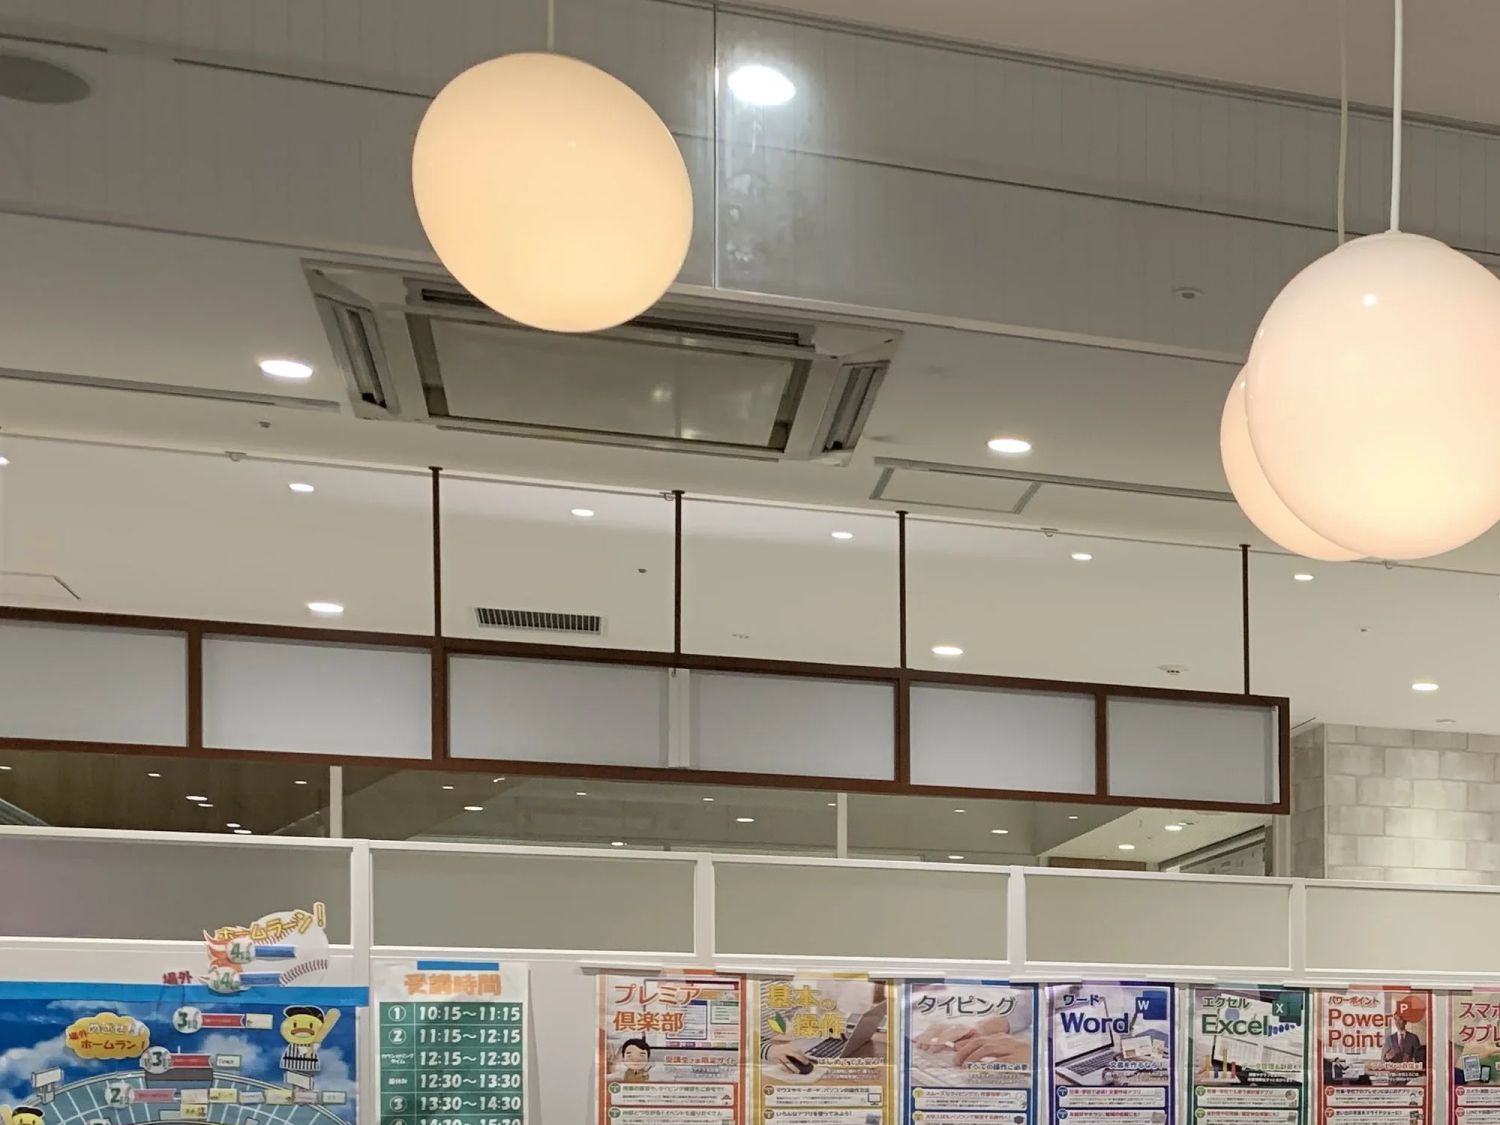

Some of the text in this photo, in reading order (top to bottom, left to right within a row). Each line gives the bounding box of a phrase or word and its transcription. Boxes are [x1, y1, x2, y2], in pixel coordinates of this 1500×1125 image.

[404, 973, 502, 996] 受講時間
[614, 984, 699, 1005] プレミア
[768, 985, 837, 1011] 基本の
[1063, 994, 1101, 1006] ワード
[1203, 997, 1250, 1009] エクセル
[1328, 996, 1380, 1005] パワーポイント
[917, 995, 1016, 1015] タイピング
[1137, 1000, 1150, 1011] W
[1275, 1003, 1284, 1014] X
[1400, 1003, 1409, 1013] P
[613, 1011, 685, 1032] 倶楽部
[794, 1013, 844, 1038] 操作
[1060, 1012, 1129, 1034] Word
[1202, 1014, 1268, 1036] Excel
[1328, 1009, 1394, 1028] Power
[1328, 1030, 1384, 1049] Point
